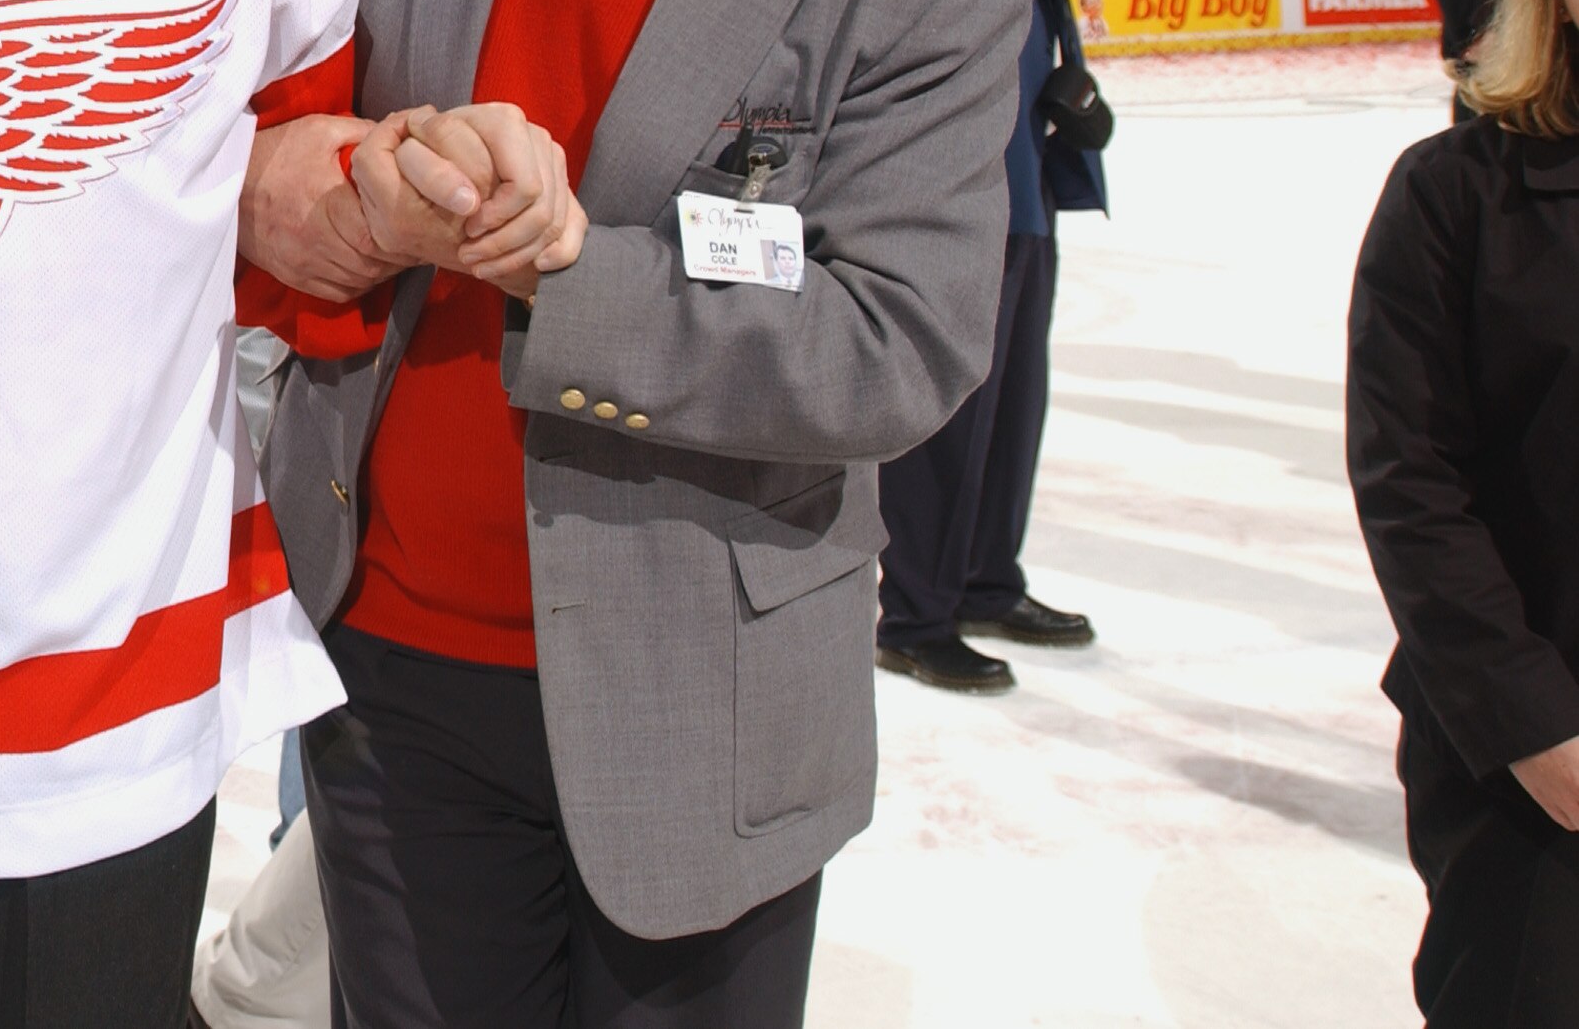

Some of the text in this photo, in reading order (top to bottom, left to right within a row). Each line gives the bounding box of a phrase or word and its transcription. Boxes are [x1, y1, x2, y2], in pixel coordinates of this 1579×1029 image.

[723, 97, 792, 132] Olympia
[709, 242, 738, 256] DAN
[711, 255, 738, 266] COLE
